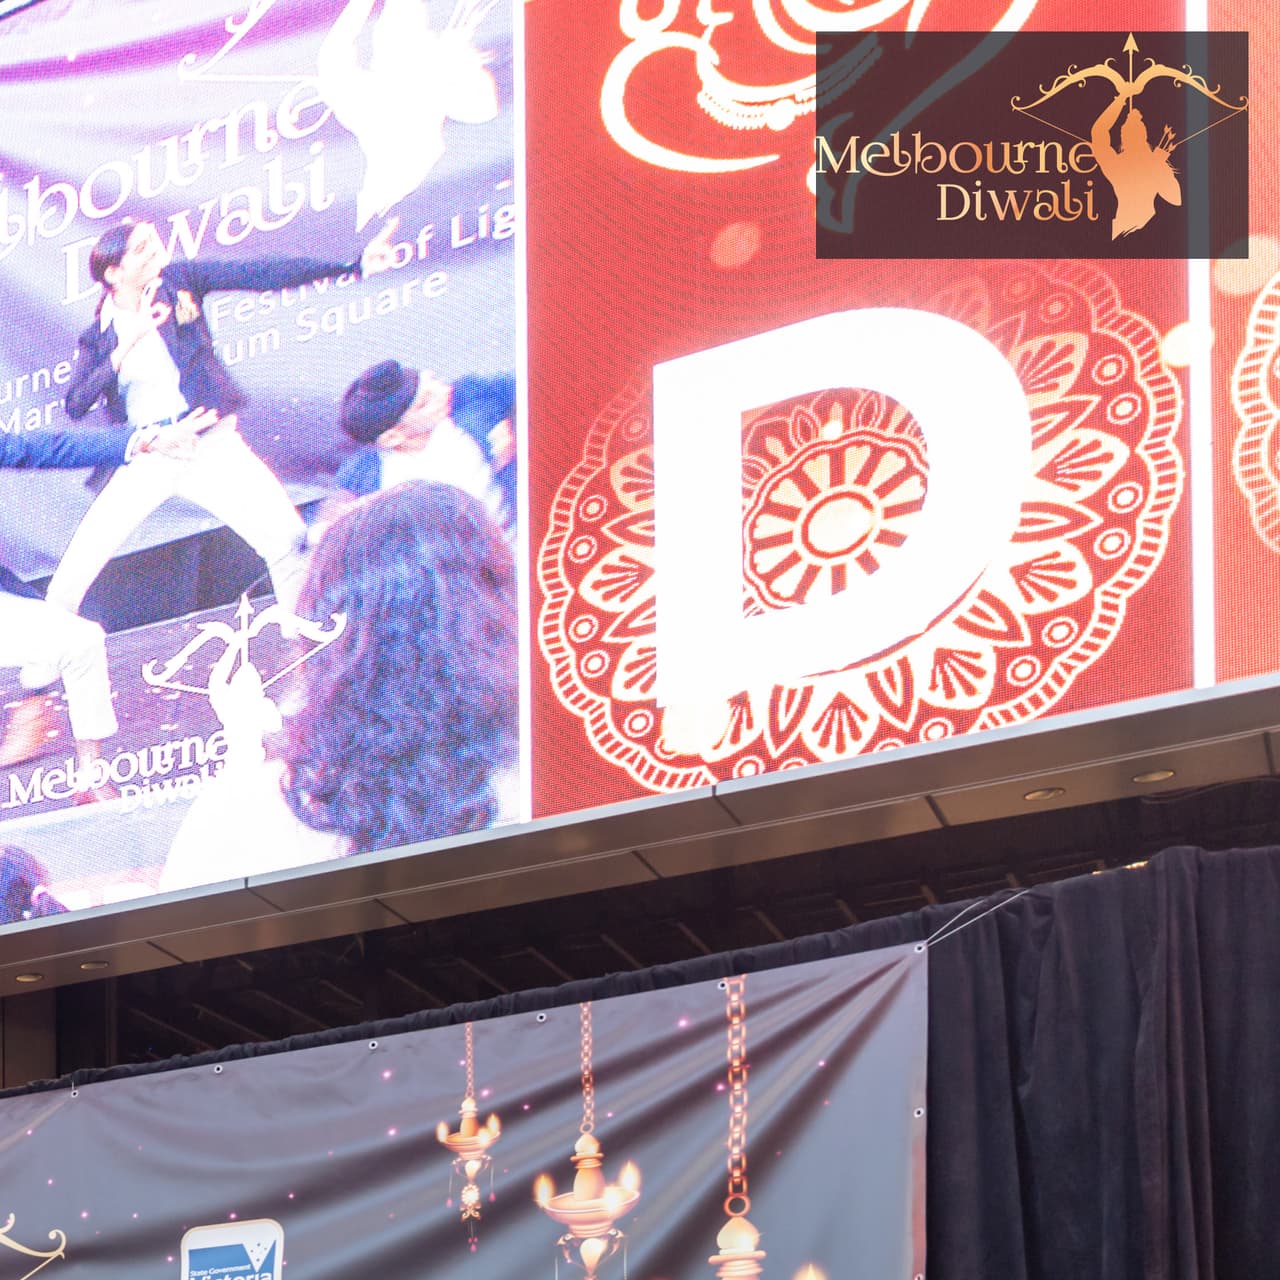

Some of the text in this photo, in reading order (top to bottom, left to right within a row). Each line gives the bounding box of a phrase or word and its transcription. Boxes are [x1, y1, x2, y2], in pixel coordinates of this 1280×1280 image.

[61, 141, 336, 306] Dwali
[389, 222, 434, 271] of
[295, 269, 449, 342] Square
[1, 729, 228, 809] Melbourne
